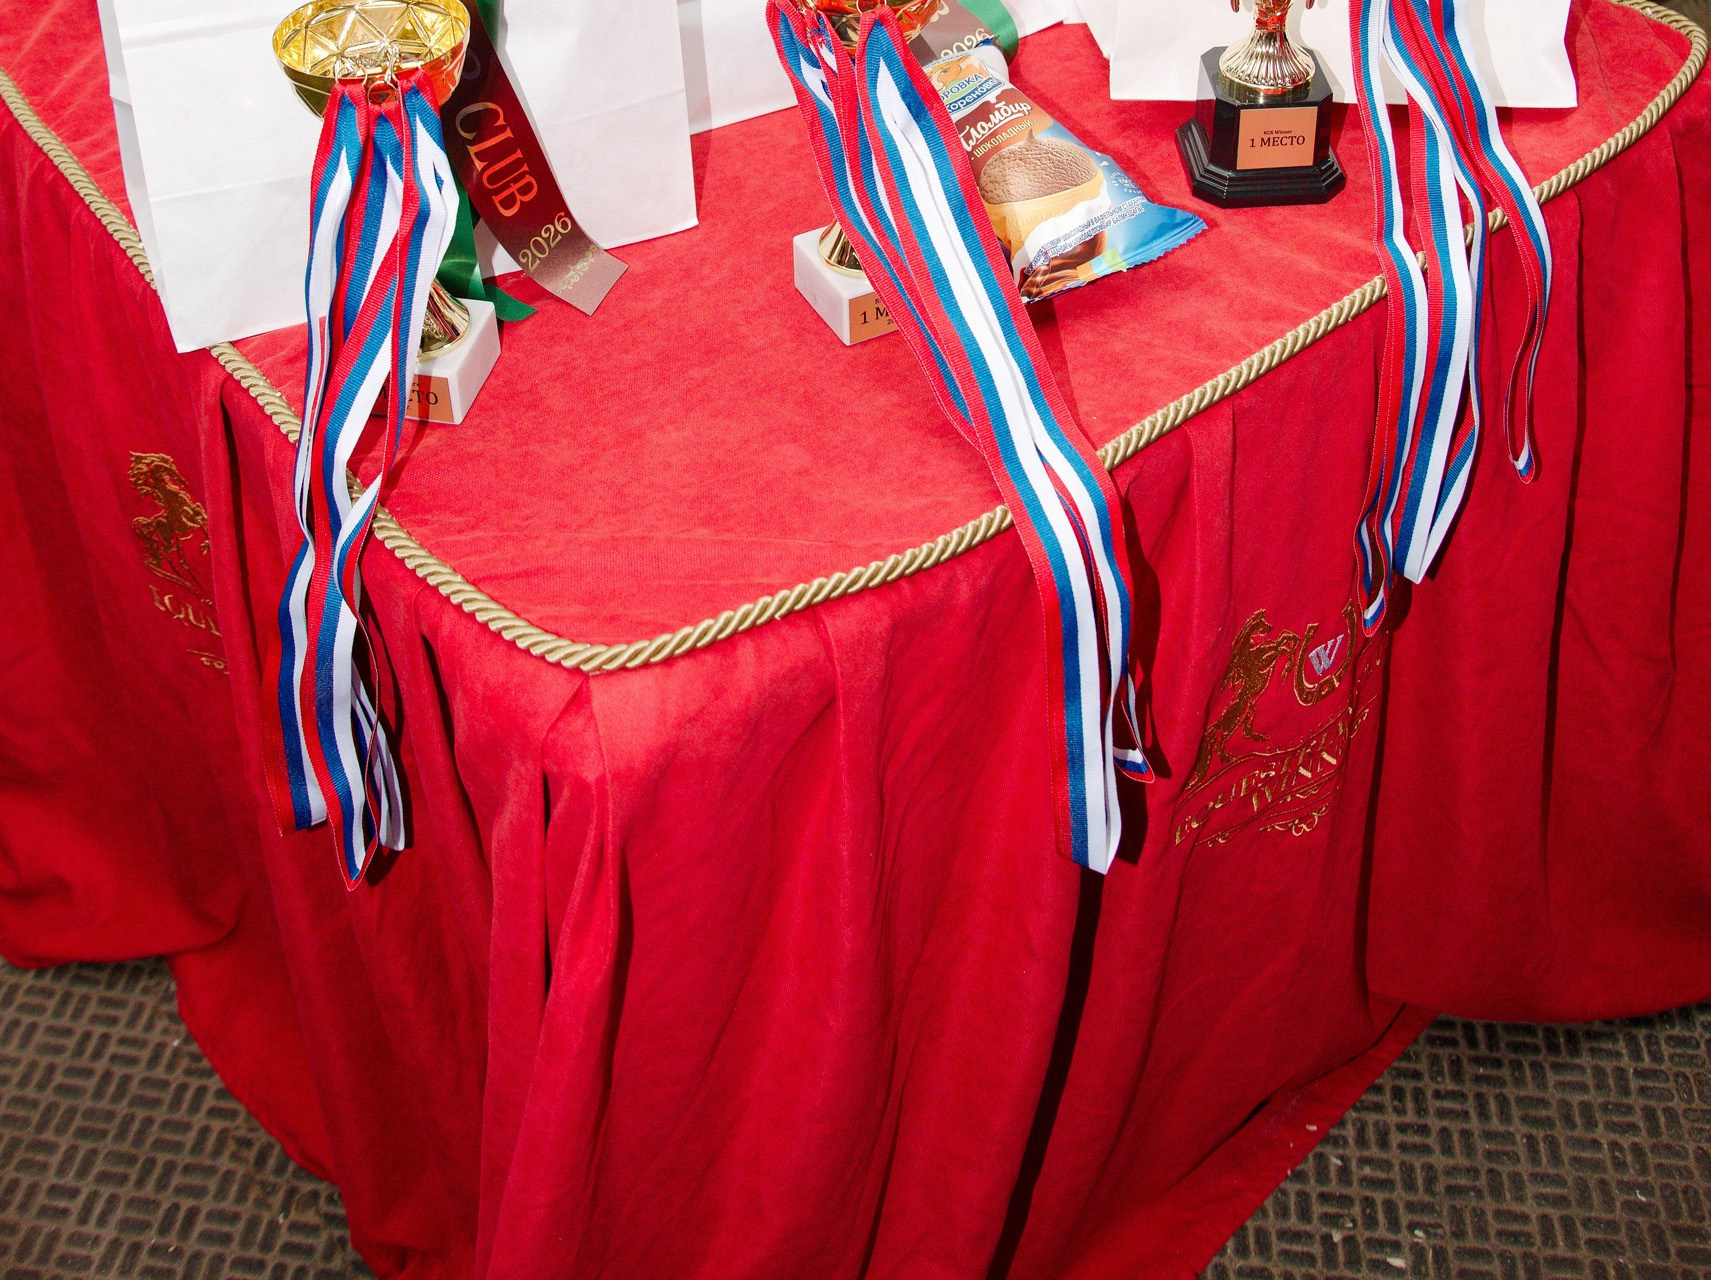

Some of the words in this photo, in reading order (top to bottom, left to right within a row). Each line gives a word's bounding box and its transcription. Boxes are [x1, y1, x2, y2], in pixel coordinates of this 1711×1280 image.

[455, 101, 538, 217] CLUB
[973, 120, 1033, 158] ШОКОЛАДНЫЙ
[1249, 138, 1256, 148] 1
[1260, 135, 1306, 148] МЕСТО
[519, 212, 572, 272] 2026
[860, 311, 869, 325] 1
[1308, 634, 1345, 676] W
